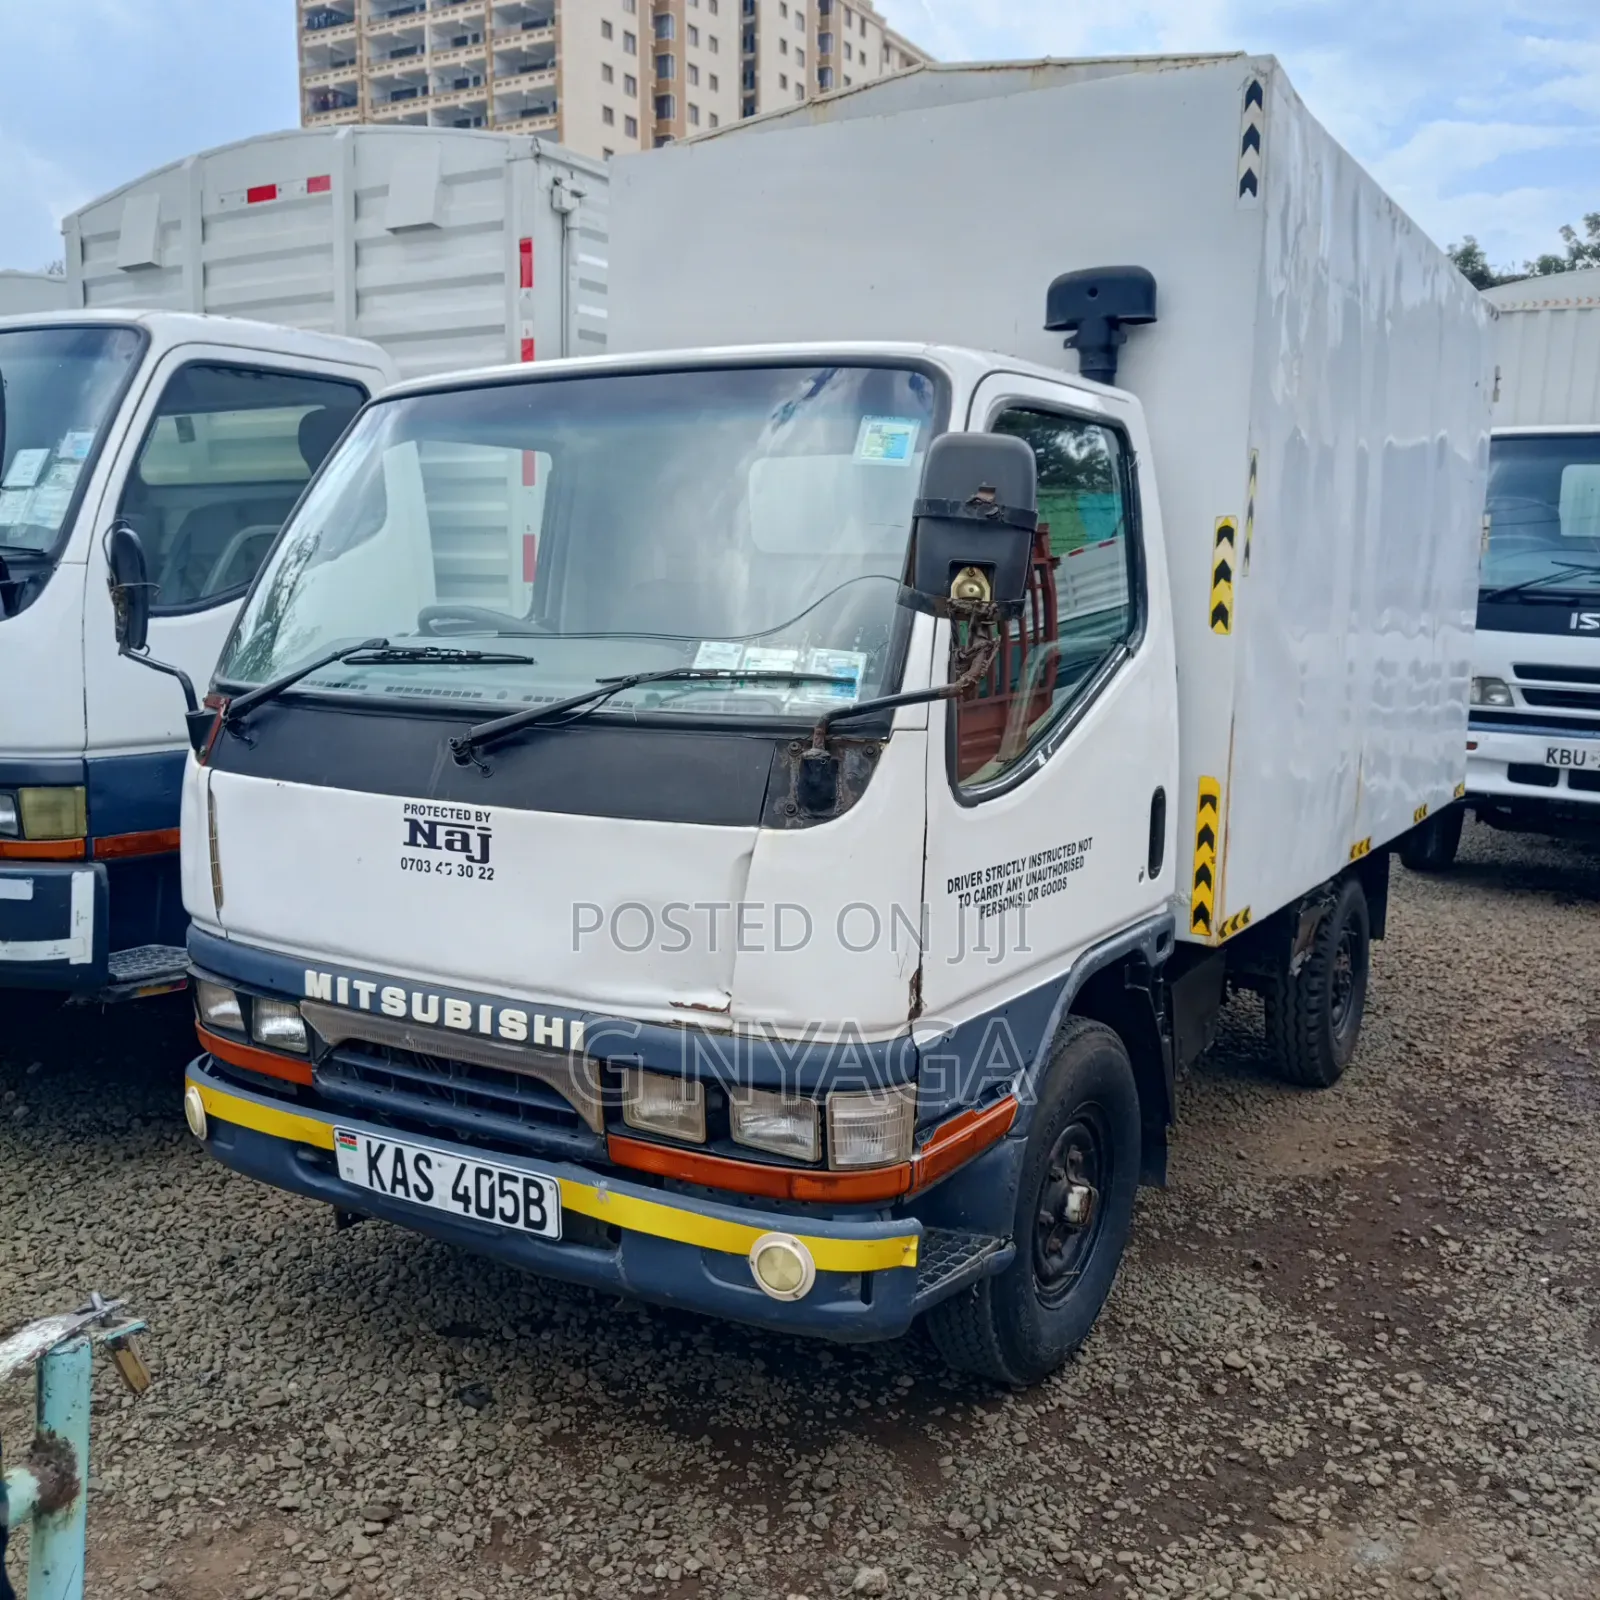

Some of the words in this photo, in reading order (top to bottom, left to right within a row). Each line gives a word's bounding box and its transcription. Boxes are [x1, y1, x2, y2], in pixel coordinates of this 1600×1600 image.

[1546, 747, 1586, 766] KBU
[403, 803, 471, 821] PROTECTED
[475, 811, 491, 823] BY
[403, 817, 492, 864] Naj
[400, 857, 431, 873] 0703
[457, 864, 474, 878] 30
[478, 866, 495, 880] 22
[947, 870, 983, 894] DRIVER
[985, 857, 1027, 882] STRICTLY
[1028, 842, 1077, 869] INSTRUCTED
[1078, 837, 1093, 853] NOT
[958, 892, 971, 909] TO
[973, 881, 1004, 904] CARRY
[1006, 875, 1023, 894] ANY
[1025, 855, 1085, 887] UNAUTHORISED
[980, 890, 1026, 920] PERSON(S)
[1028, 886, 1039, 902] OR
[1041, 876, 1068, 897] GOODS
[304, 969, 585, 1051] MITSUBISHI
[366, 1140, 434, 1202] KAS
[451, 1162, 548, 1232] 405B
